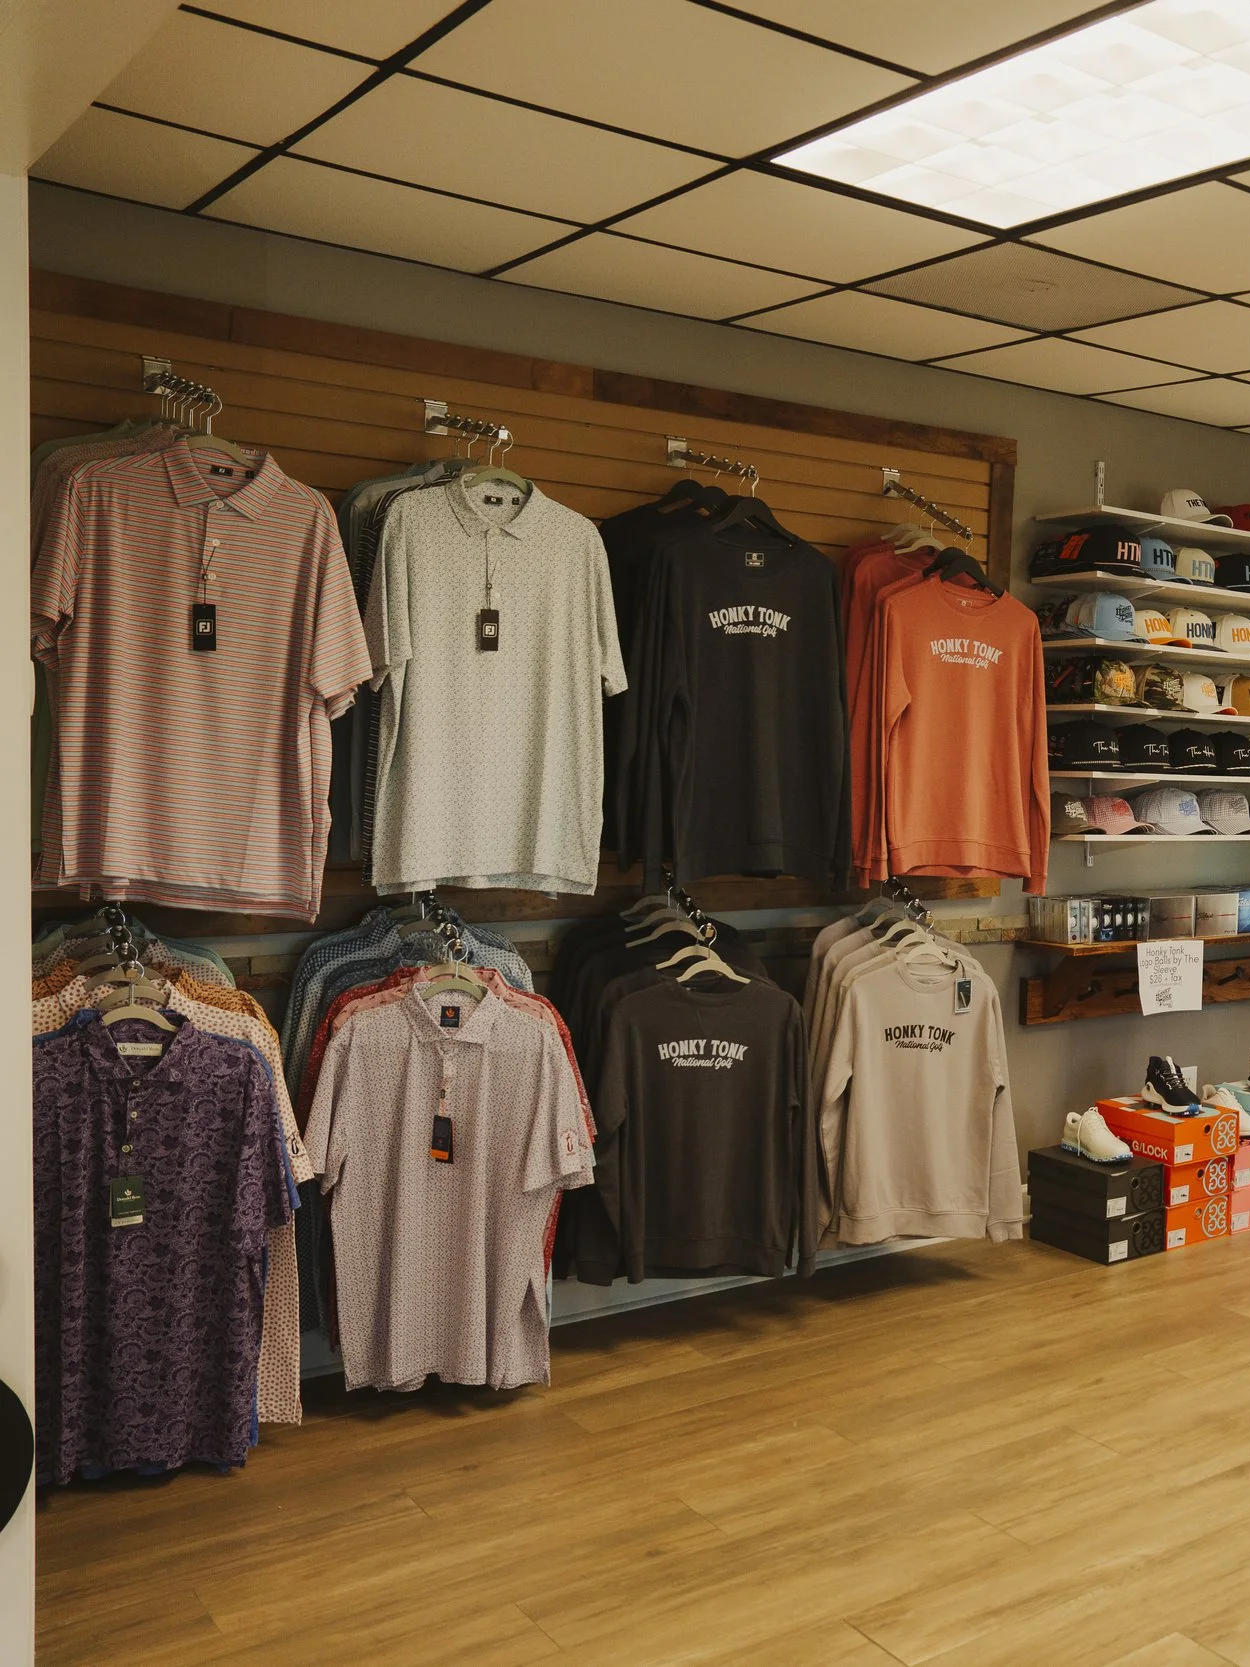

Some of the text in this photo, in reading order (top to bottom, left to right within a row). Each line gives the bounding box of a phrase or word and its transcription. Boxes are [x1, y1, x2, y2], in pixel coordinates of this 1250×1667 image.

[709, 605, 791, 632] HONKY TONK
[724, 623, 778, 638] National Golf
[930, 638, 1003, 665] HONKY TONK
[940, 653, 989, 669] National Golf
[1146, 945, 1185, 958] Honky Tonk
[1154, 956, 1171, 966] Balls
[1173, 955, 1182, 966] by
[1184, 954, 1200, 963] The
[1153, 966, 1177, 975] Sleeve
[1170, 972, 1182, 982] Tax
[884, 1024, 956, 1046] HONKY TONK
[657, 1039, 749, 1061] HONKY TONK
[895, 1040, 944, 1052] National Golf
[672, 1056, 733, 1070] National Golf
[1132, 1140, 1168, 1160] G/LOCK
